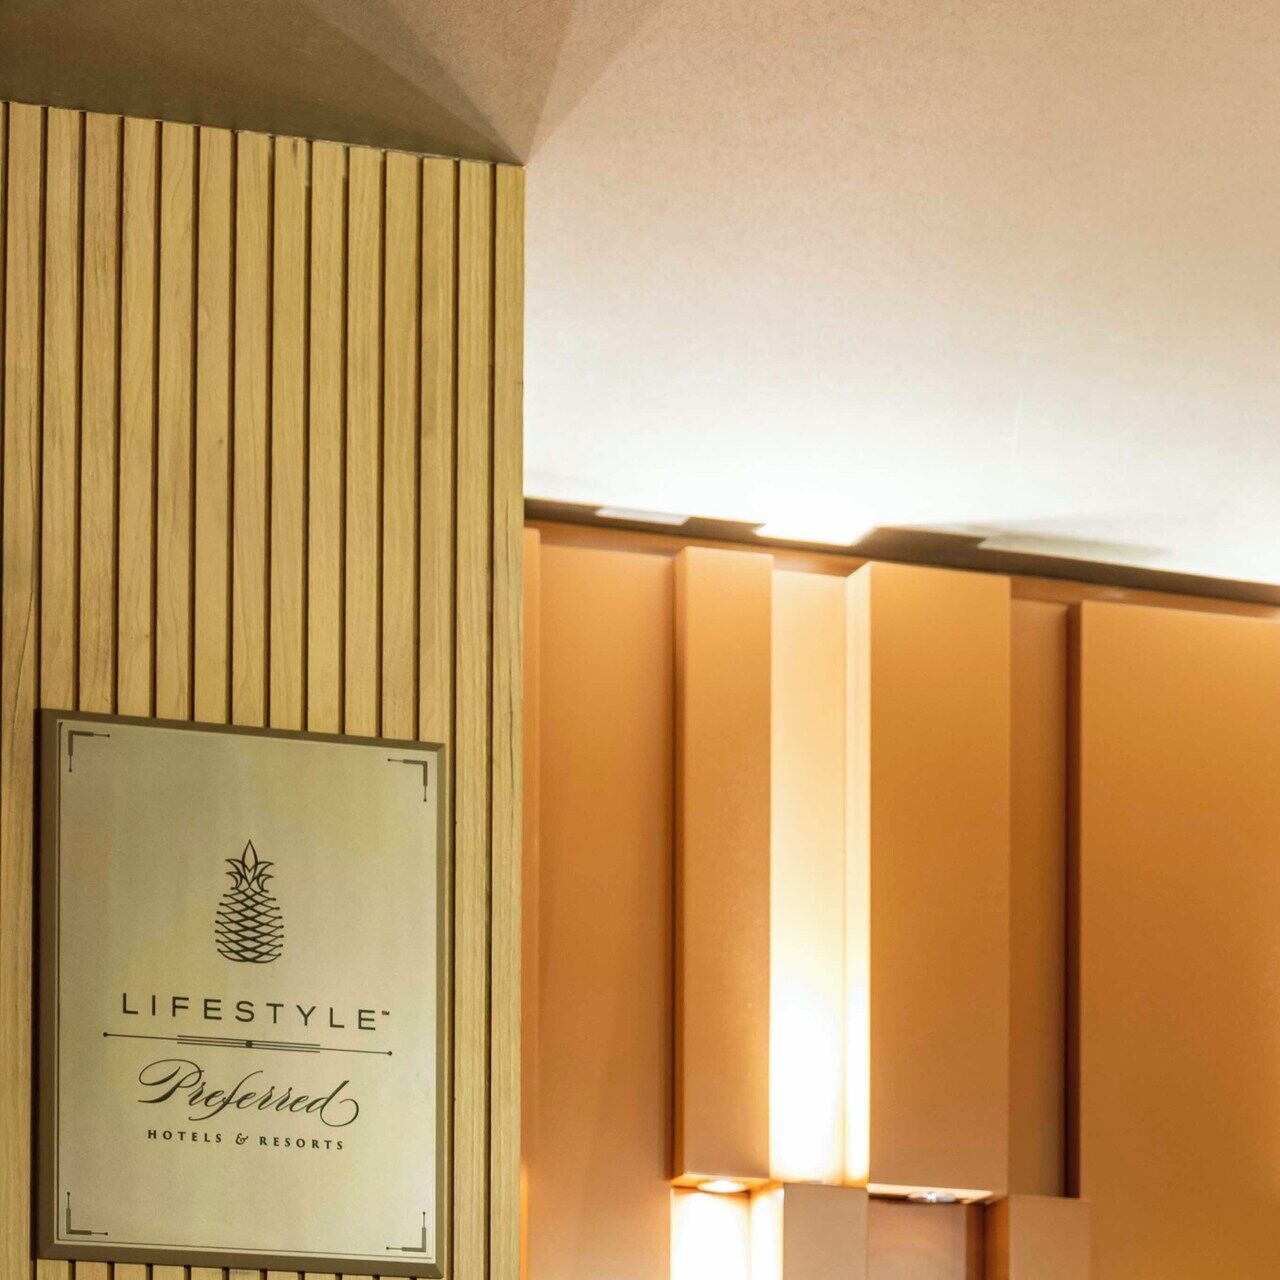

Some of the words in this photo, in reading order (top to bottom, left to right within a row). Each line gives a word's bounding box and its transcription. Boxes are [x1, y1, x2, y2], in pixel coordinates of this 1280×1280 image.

[138, 1058, 359, 1127] Preferred
[147, 1129, 221, 1143] HOTELS
[234, 1132, 249, 1146] &
[259, 1135, 342, 1150] RESORTS
